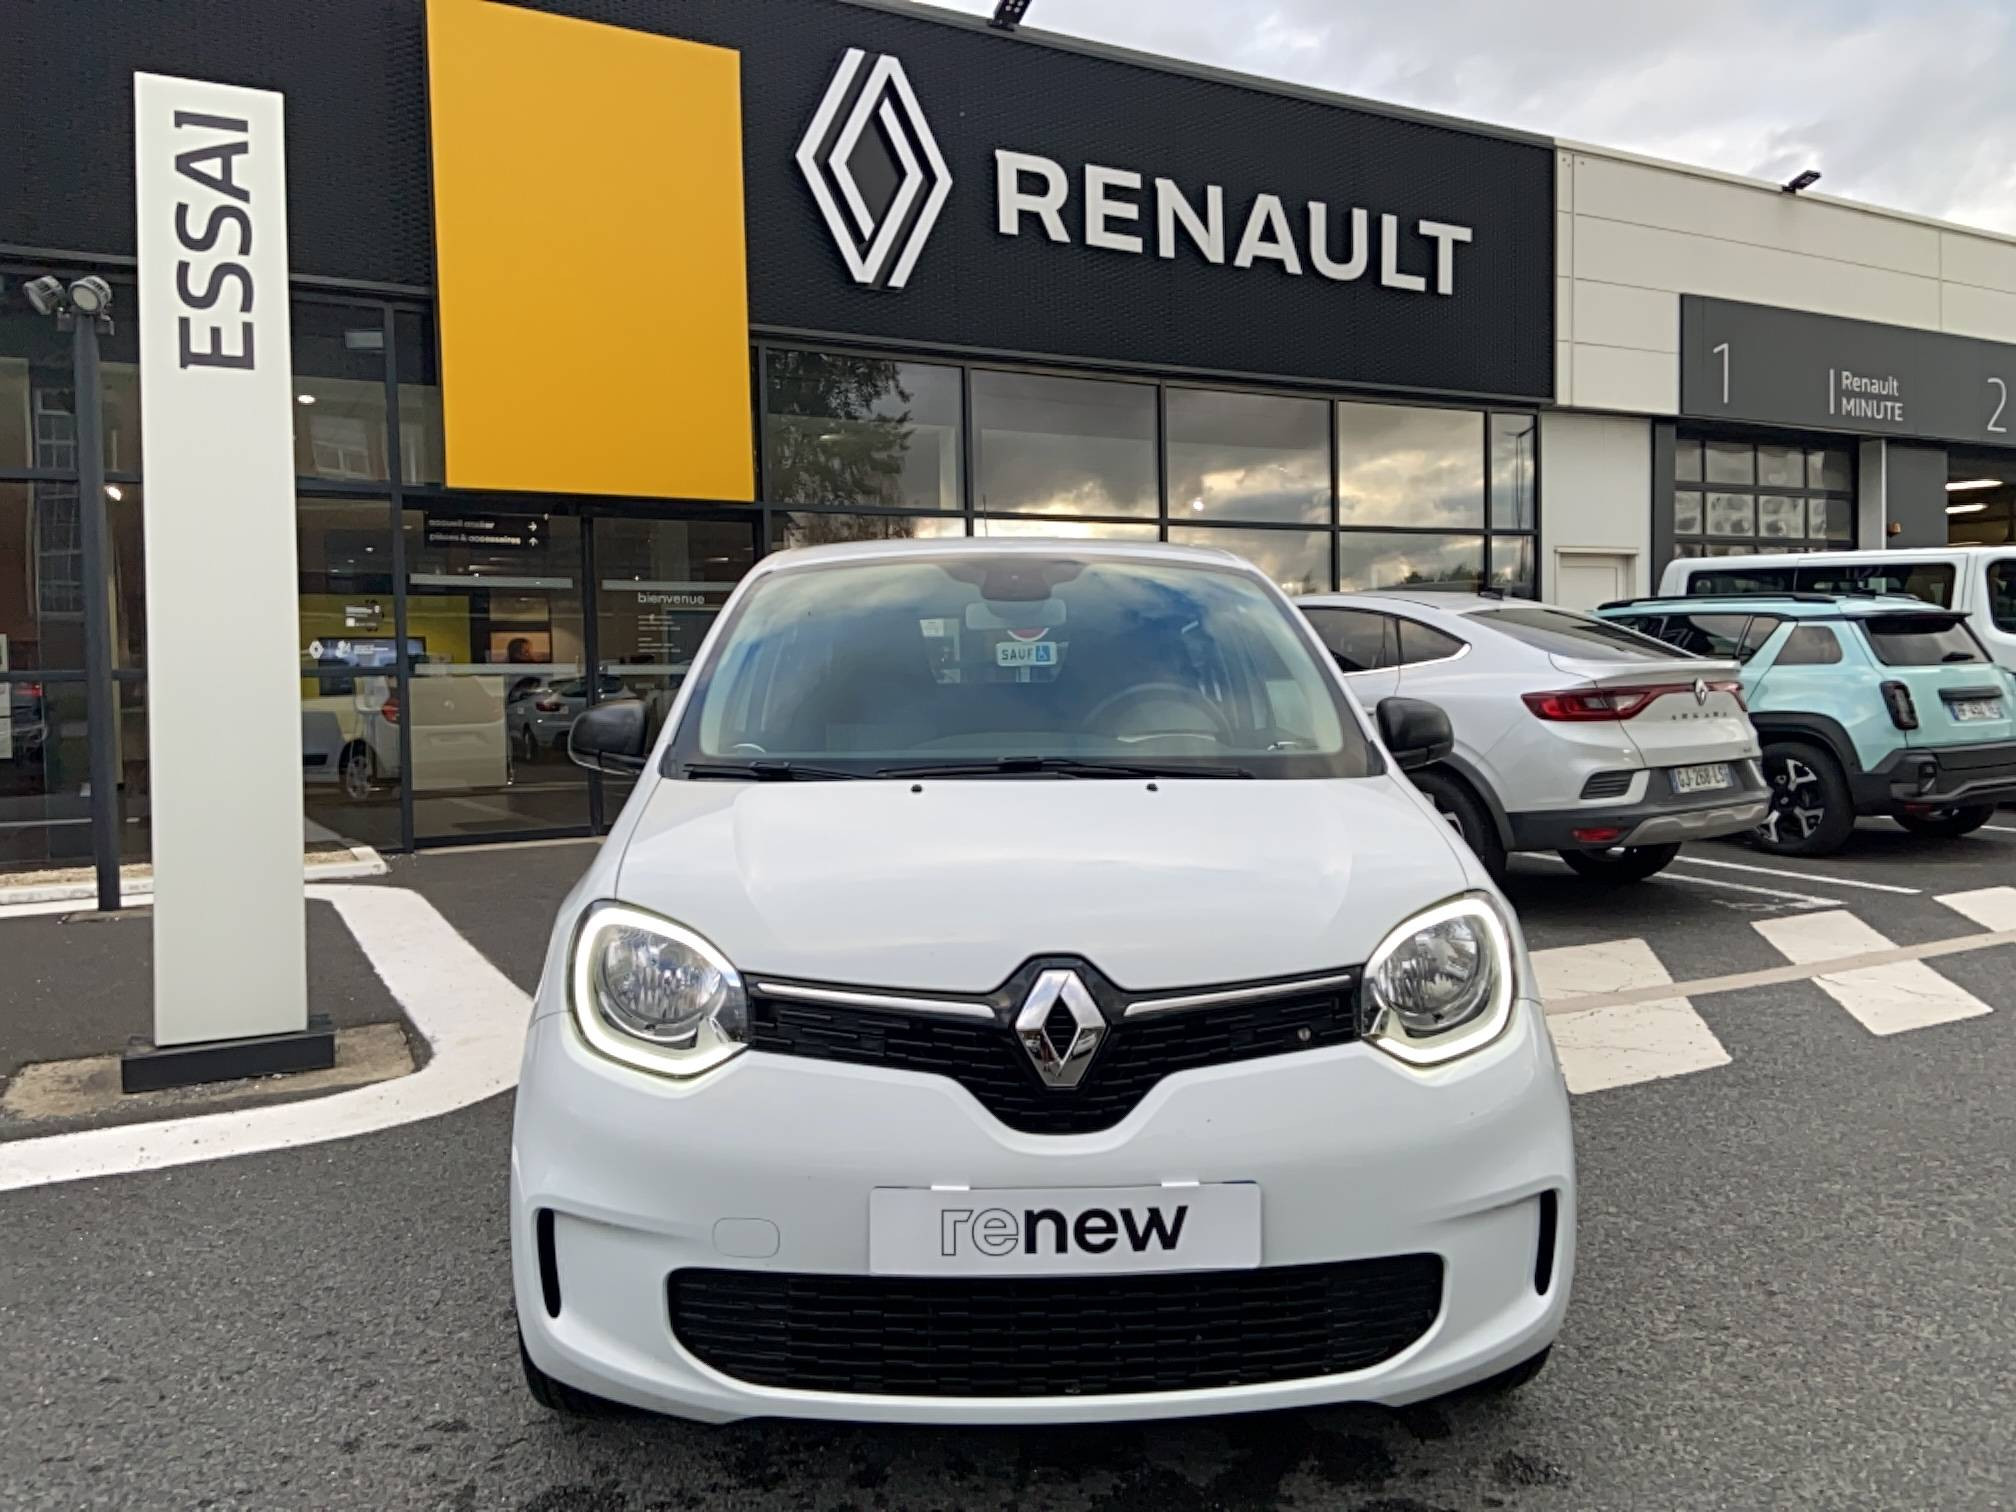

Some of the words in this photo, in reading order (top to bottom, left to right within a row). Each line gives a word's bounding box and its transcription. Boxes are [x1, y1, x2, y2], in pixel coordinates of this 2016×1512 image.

[173, 110, 255, 371] ESSAI
[995, 148, 1474, 296] RENAULT
[1712, 342, 1730, 404] 1
[1841, 370, 1900, 397] Renault
[1841, 397, 1904, 422] MINUTE
[1986, 377, 2008, 433] 2
[637, 591, 705, 605] bienvenue
[1001, 647, 1034, 661] SAUF
[941, 1205, 1189, 1257] renew
